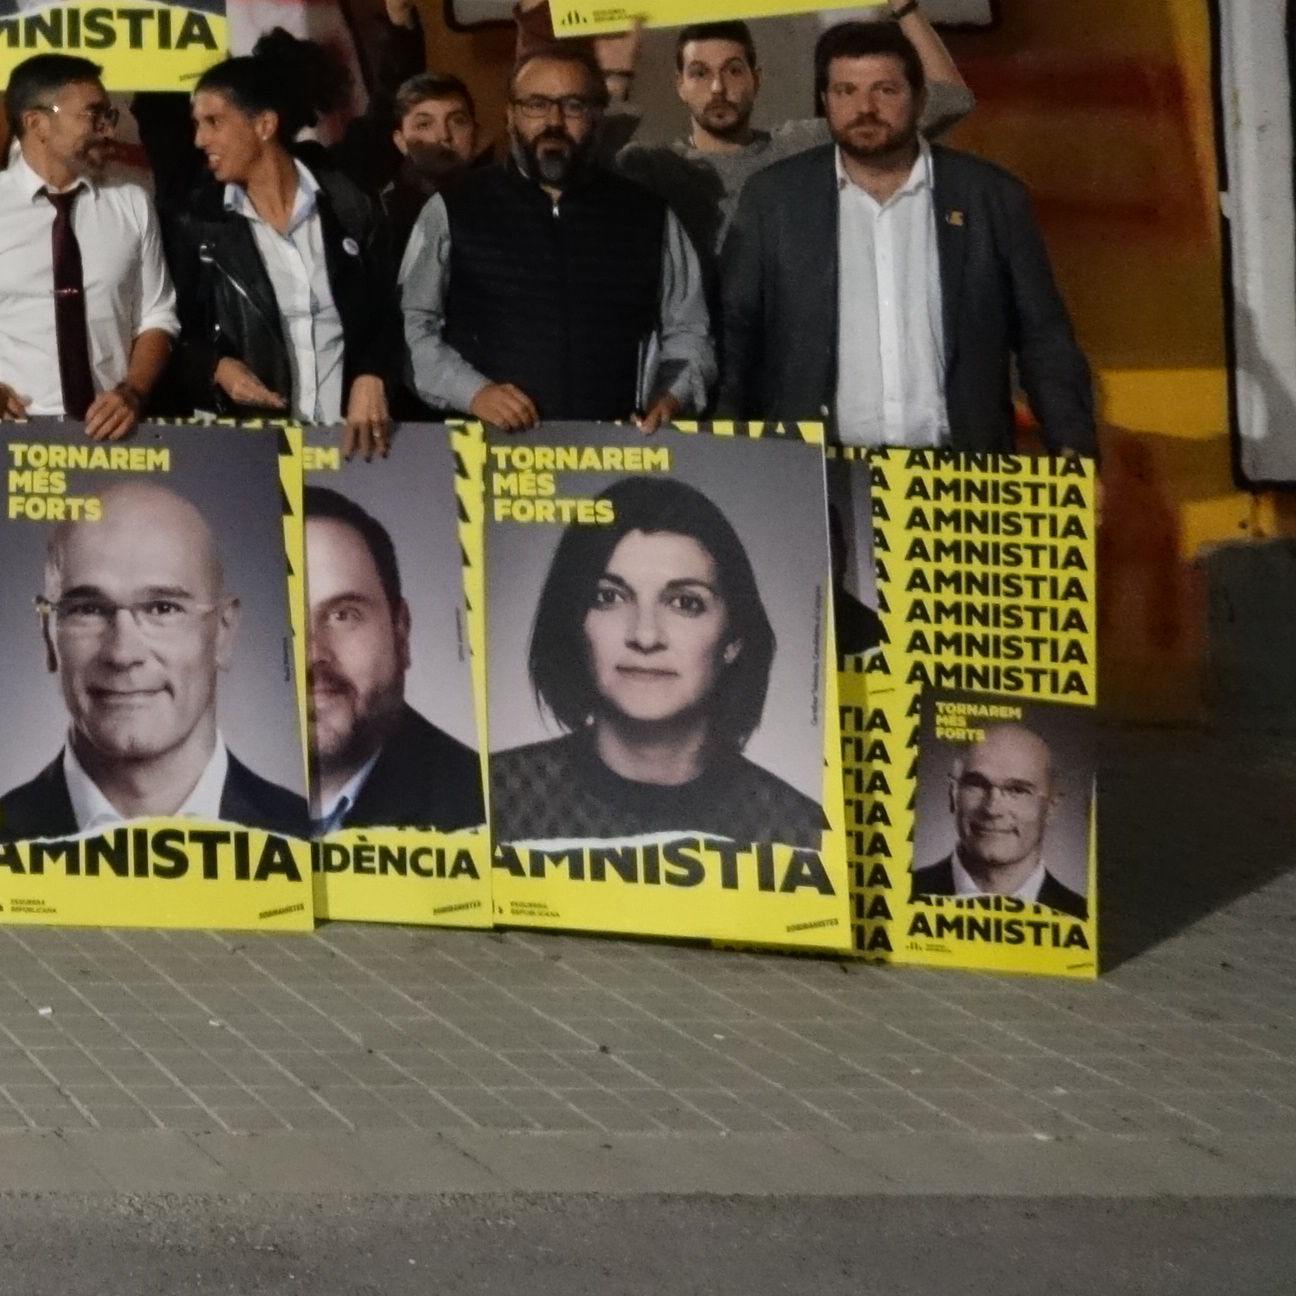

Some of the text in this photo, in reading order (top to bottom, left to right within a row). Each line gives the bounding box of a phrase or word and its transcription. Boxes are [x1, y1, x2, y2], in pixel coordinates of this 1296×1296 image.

[9, 444, 170, 472] TORNAREM
[491, 446, 670, 471] TORNAREM
[905, 449, 1086, 478] AMNISTIA
[9, 468, 66, 494] MÉS
[492, 467, 555, 496] MÉS
[905, 476, 1087, 508] AMNISTIA
[8, 497, 101, 522] FORTS
[494, 498, 615, 524] FORTES
[905, 507, 1087, 540] AMNISTIA
[905, 538, 1087, 570] AMNISTIA
[905, 568, 1088, 602] AMNISTIA
[905, 599, 1088, 633] AMNISTIA
[906, 630, 1088, 664] AMNISTIA
[906, 661, 1088, 695] AMNISTIA
[935, 702, 1022, 720] TORNAREM
[935, 727, 985, 742] FORTS
[492, 837, 836, 896] AMNISTIA
[908, 912, 1090, 950] AMNISTIA
